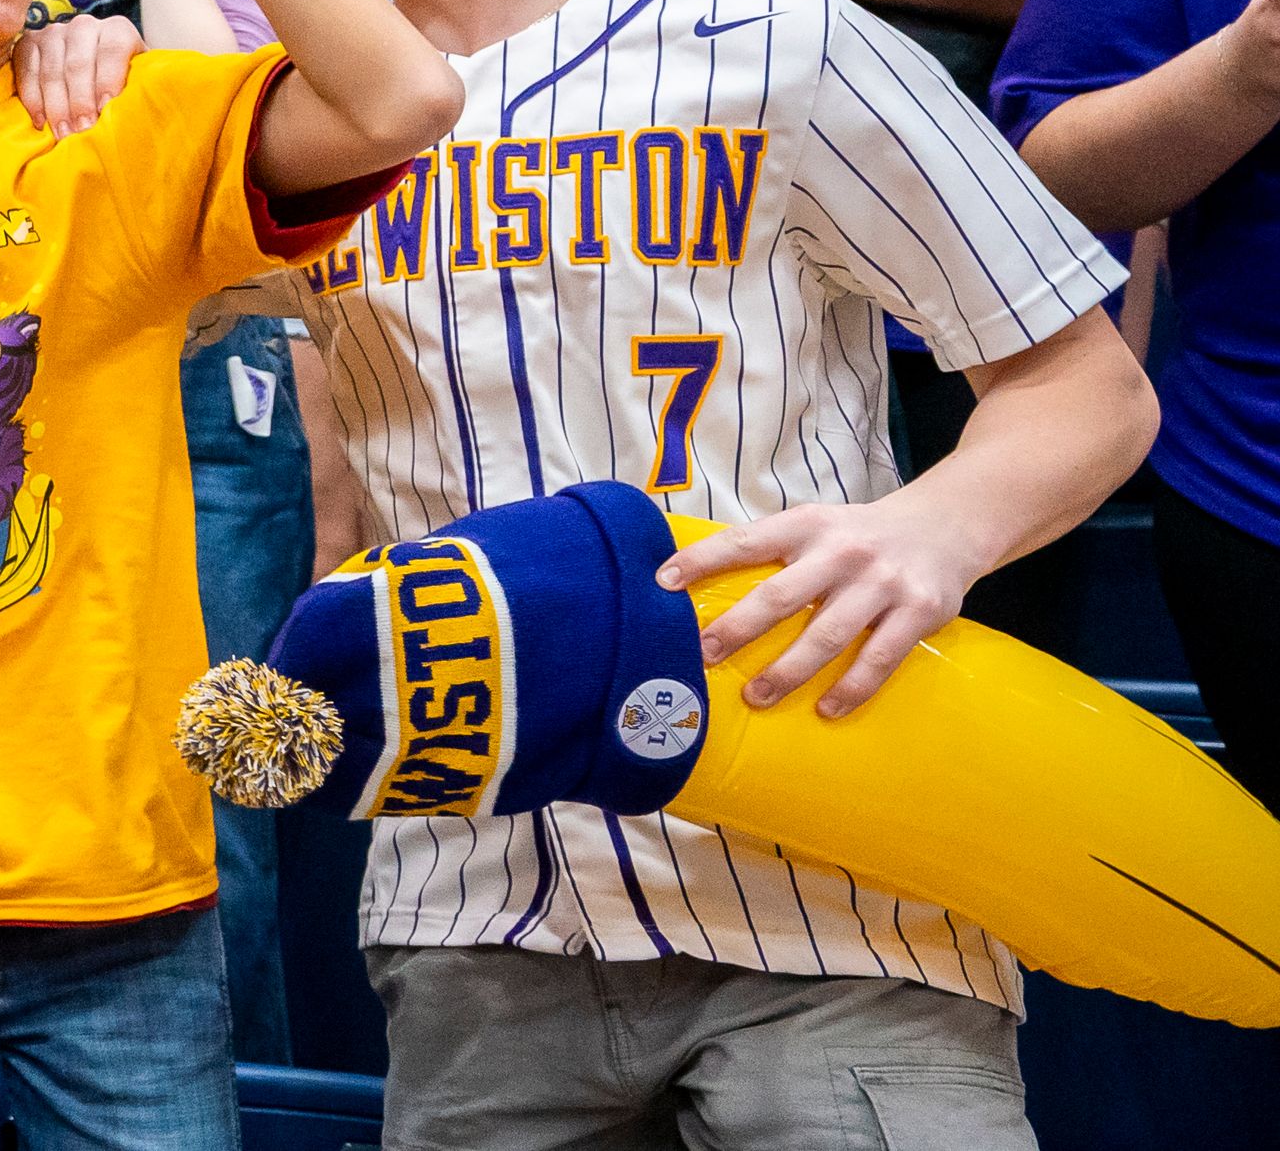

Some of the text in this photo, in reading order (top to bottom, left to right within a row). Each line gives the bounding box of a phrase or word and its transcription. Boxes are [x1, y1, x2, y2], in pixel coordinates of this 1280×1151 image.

[631, 334, 724, 494] 7
[647, 690, 674, 747] L B
